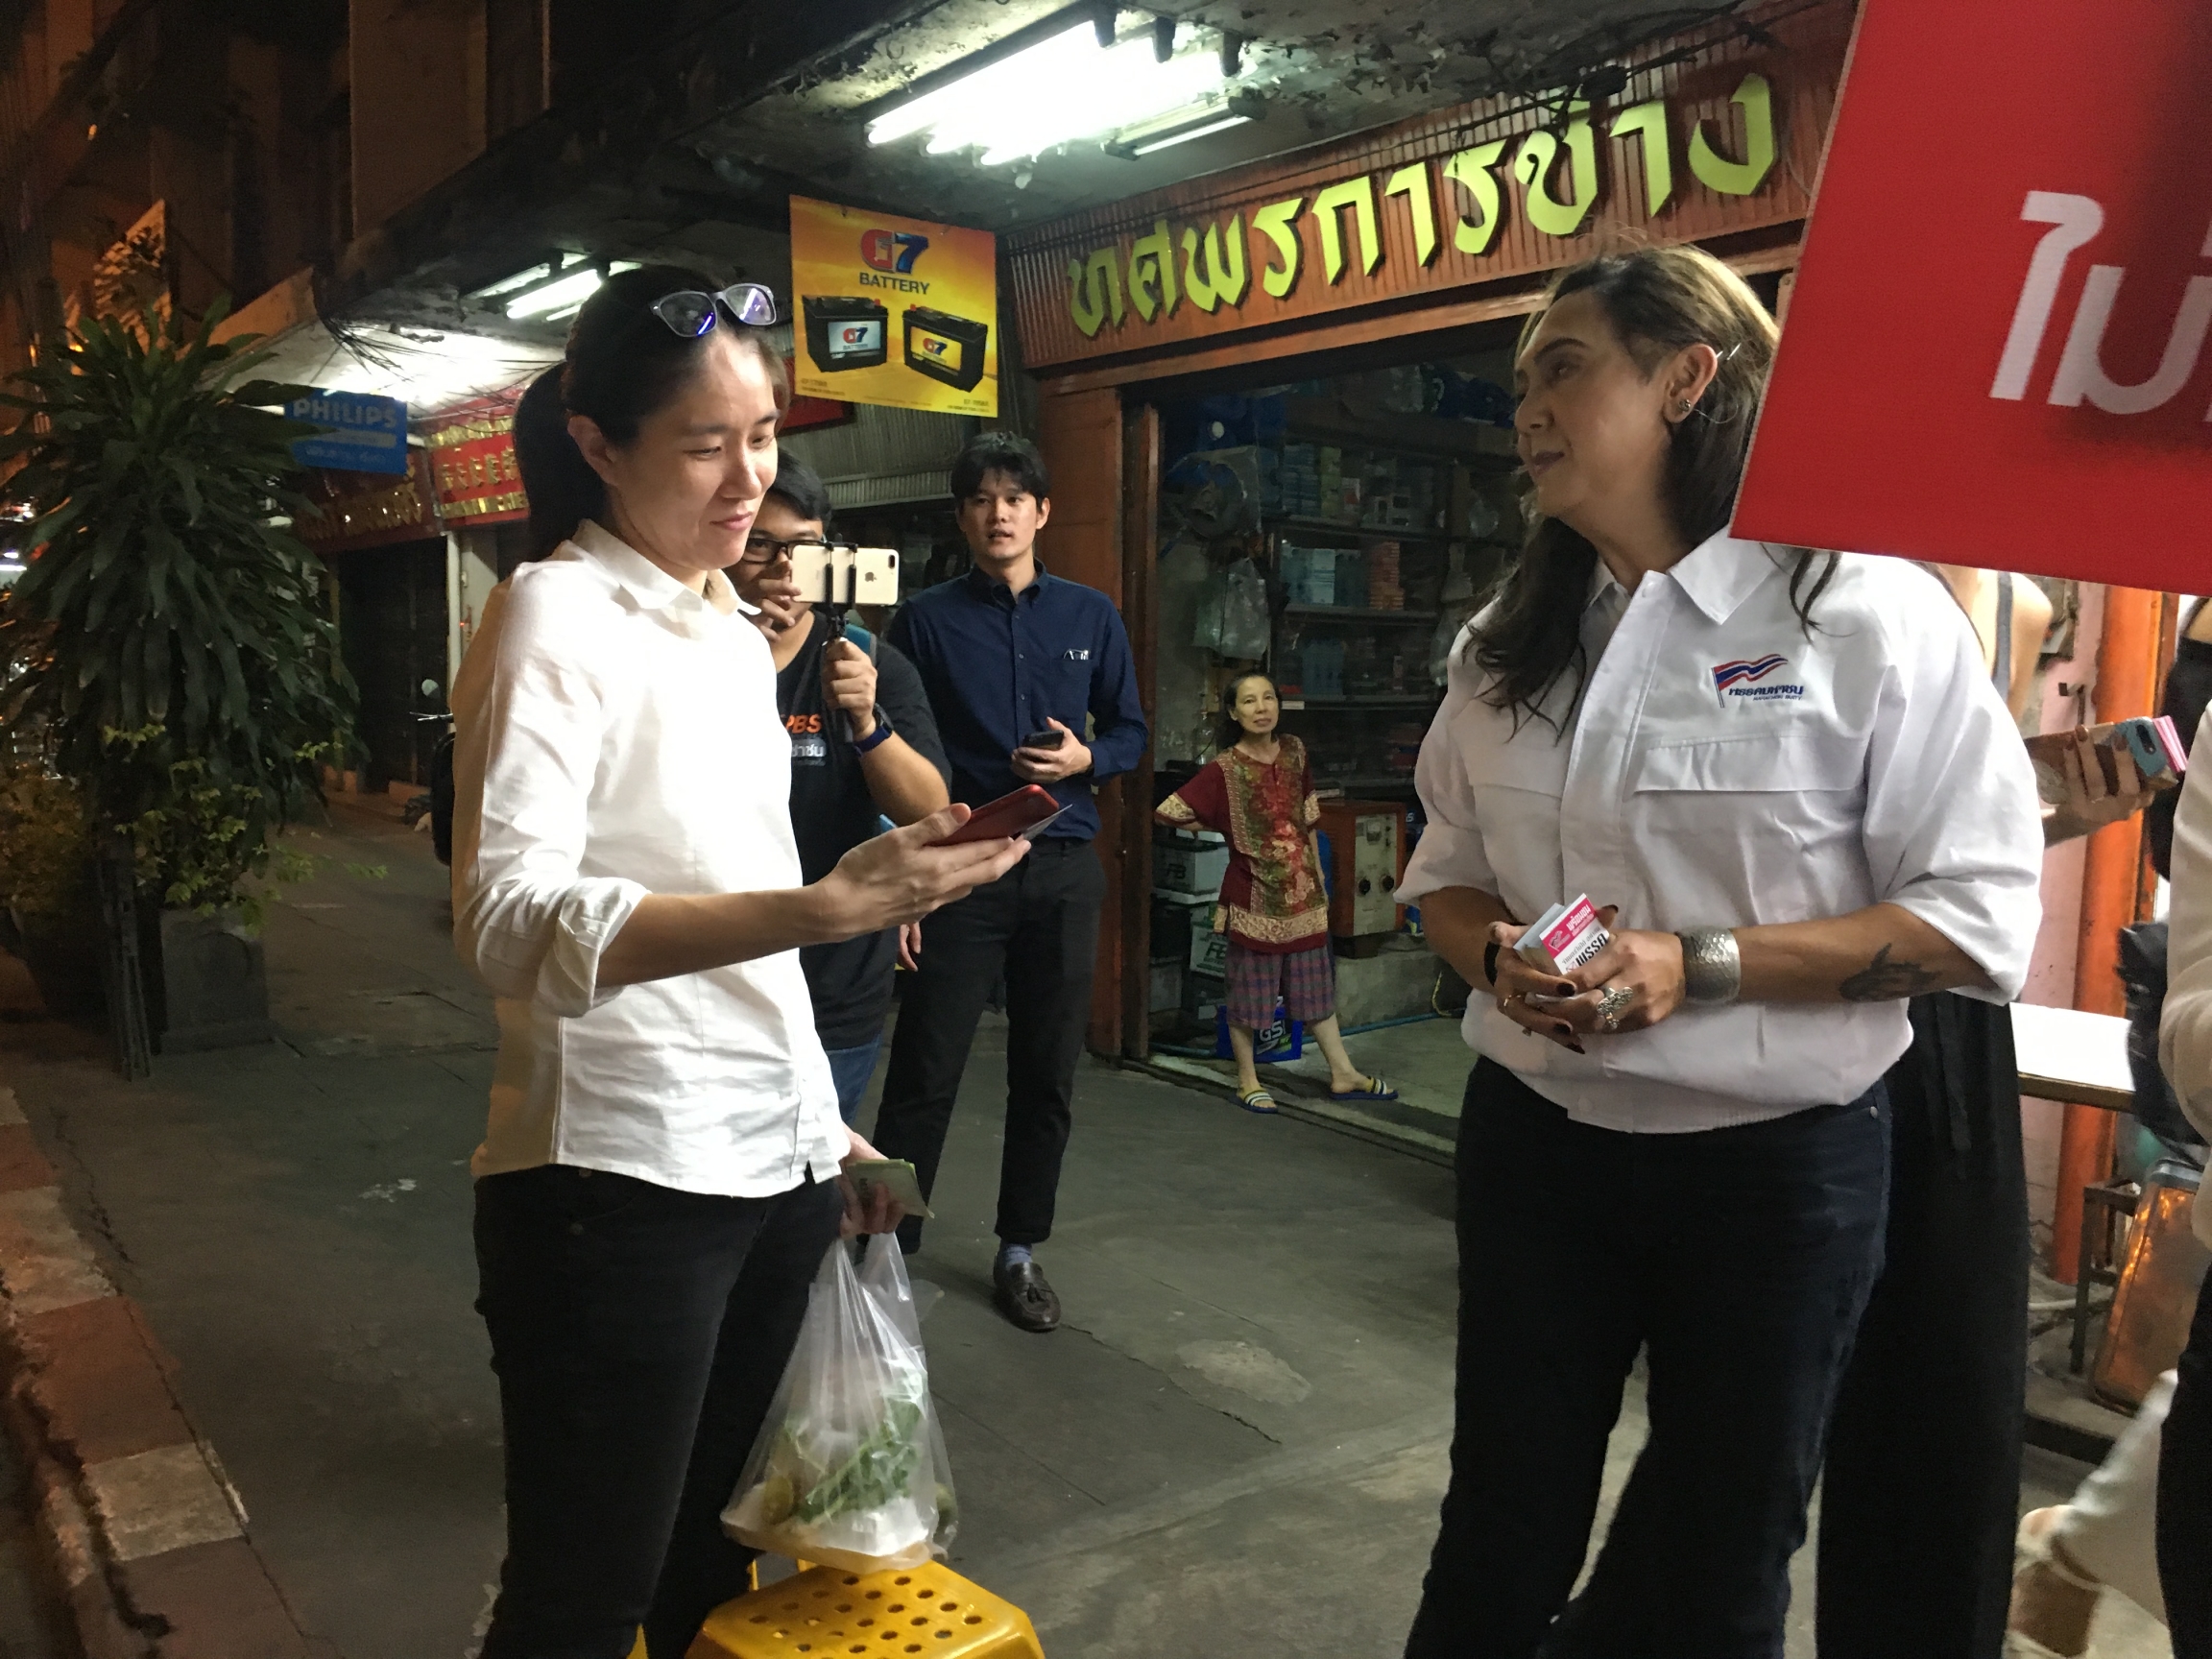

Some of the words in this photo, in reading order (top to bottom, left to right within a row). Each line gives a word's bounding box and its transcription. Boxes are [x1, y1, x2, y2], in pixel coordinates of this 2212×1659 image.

[859, 272, 930, 296] BATTERY
[293, 398, 397, 429] PHILIPS
[1259, 1020, 1284, 1043] GS
